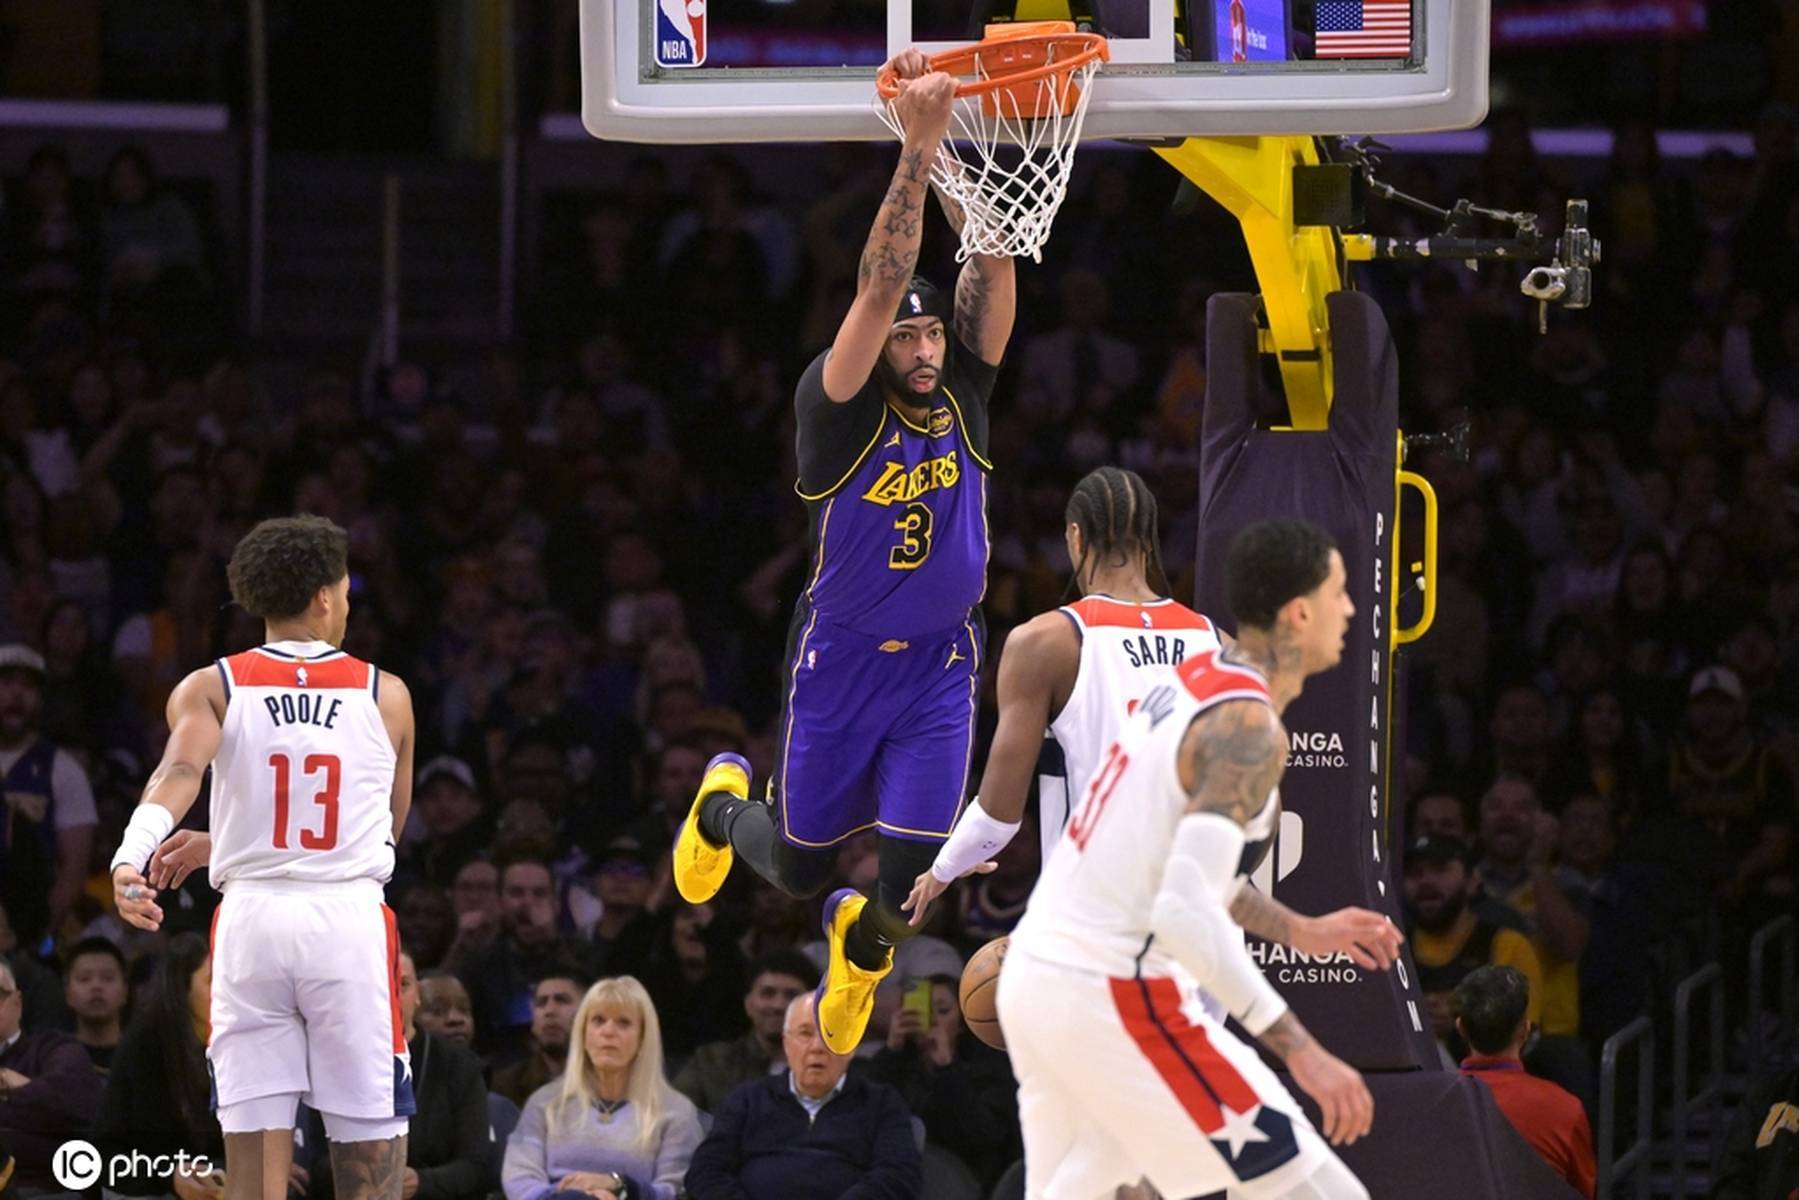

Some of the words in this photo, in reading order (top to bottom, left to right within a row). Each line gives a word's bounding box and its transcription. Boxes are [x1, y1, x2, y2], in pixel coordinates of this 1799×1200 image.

[662, 40, 688, 60] NBA
[861, 451, 961, 506] LAKERS
[888, 502, 934, 570] 3
[1122, 635, 1186, 668] SARR
[263, 693, 343, 730] POOLE
[1287, 732, 1342, 752] NGA
[268, 753, 341, 850] 13
